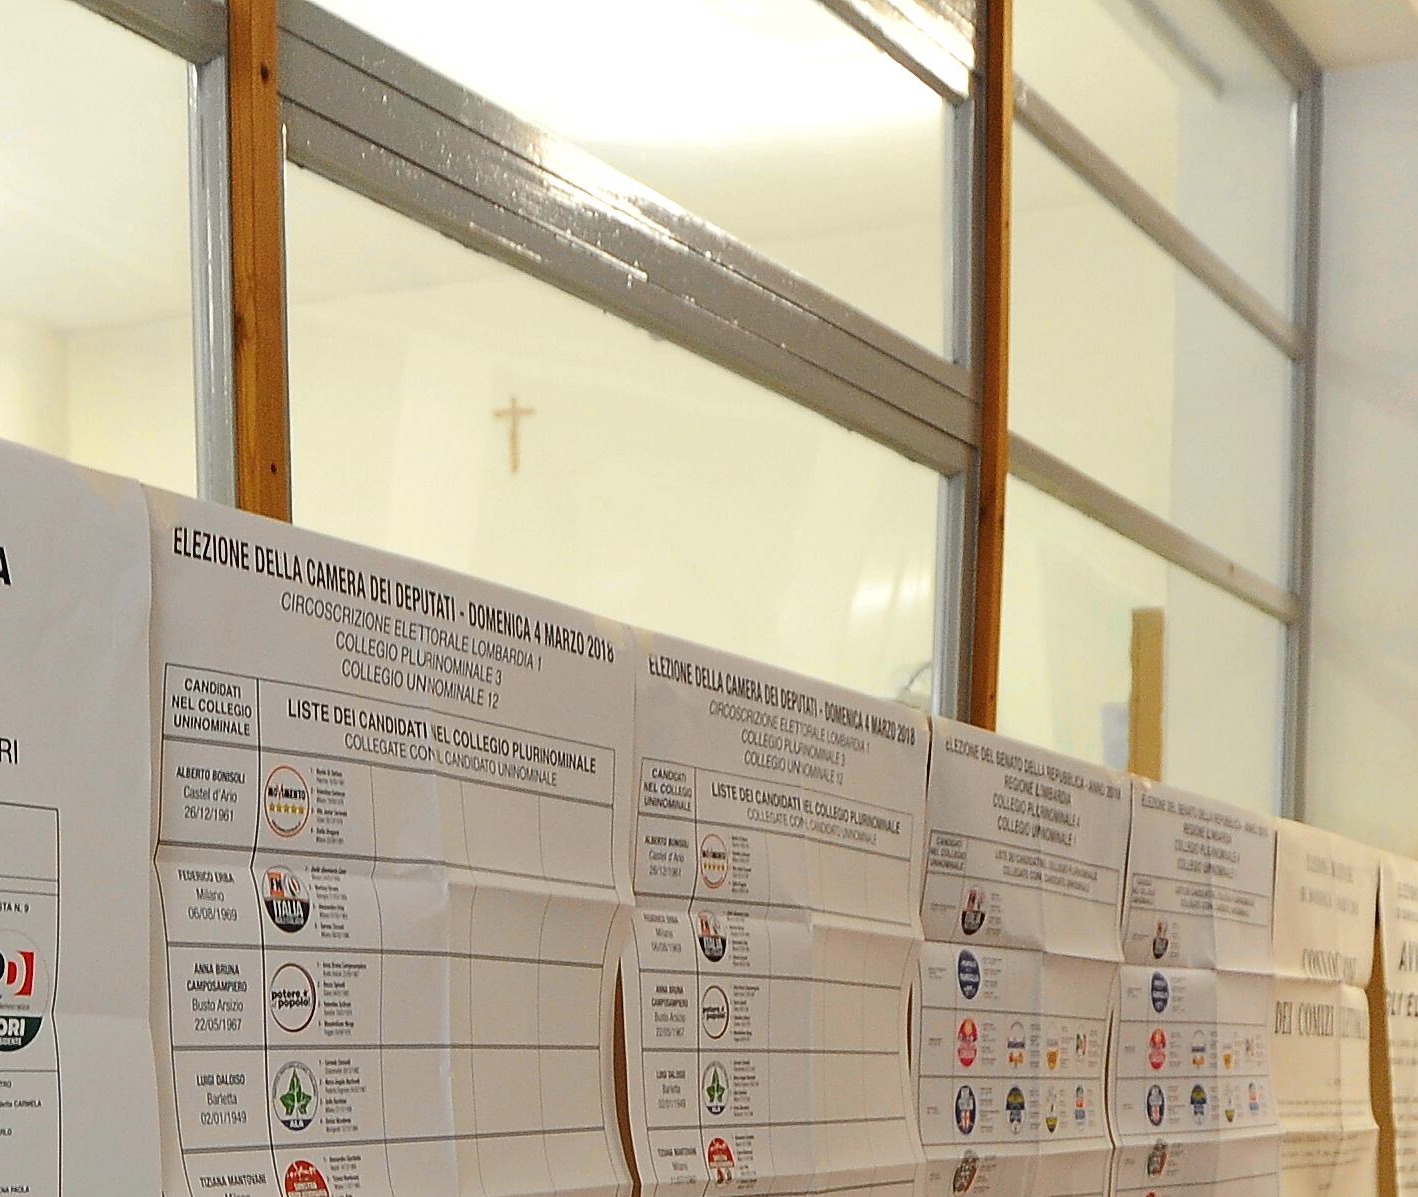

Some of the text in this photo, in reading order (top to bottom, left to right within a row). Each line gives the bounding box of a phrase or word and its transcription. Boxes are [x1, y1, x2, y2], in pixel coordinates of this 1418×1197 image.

[174, 527, 249, 572] ELEZIONE
[255, 545, 302, 583] DELLA
[307, 561, 366, 599] CAMERA
[370, 577, 392, 604] DEI
[396, 582, 455, 622] DEPUTATI
[468, 606, 530, 642] DOMENICA
[534, 620, 541, 641] 4
[544, 623, 585, 655] MARZO
[281, 592, 533, 669] CIRCOSCRIZIONE ELETTORALE LOMBARDIA
[336, 631, 397, 663] COLLEGIO
[496, 670, 502, 686] 3
[184, 678, 241, 697] CANDIDATI
[342, 659, 499, 709] COLLEGIO 12
[649, 656, 692, 684] ELEZIONE
[695, 664, 723, 692] DELLA
[726, 673, 762, 702] CAMERA
[765, 684, 778, 706] DEI
[172, 695, 252, 719] NEL COLLEGIO
[173, 715, 250, 736] UNINOMINALE
[288, 698, 596, 773] LISTE DEI CANDIDATI COLLEGIO PLURINOMINALE
[176, 766, 210, 780] ALBERTO
[184, 786, 210, 799] Castel
[712, 782, 736, 799] LISTE
[184, 806, 233, 821] 26/12/1961
[192, 999, 215, 1011] Busto
